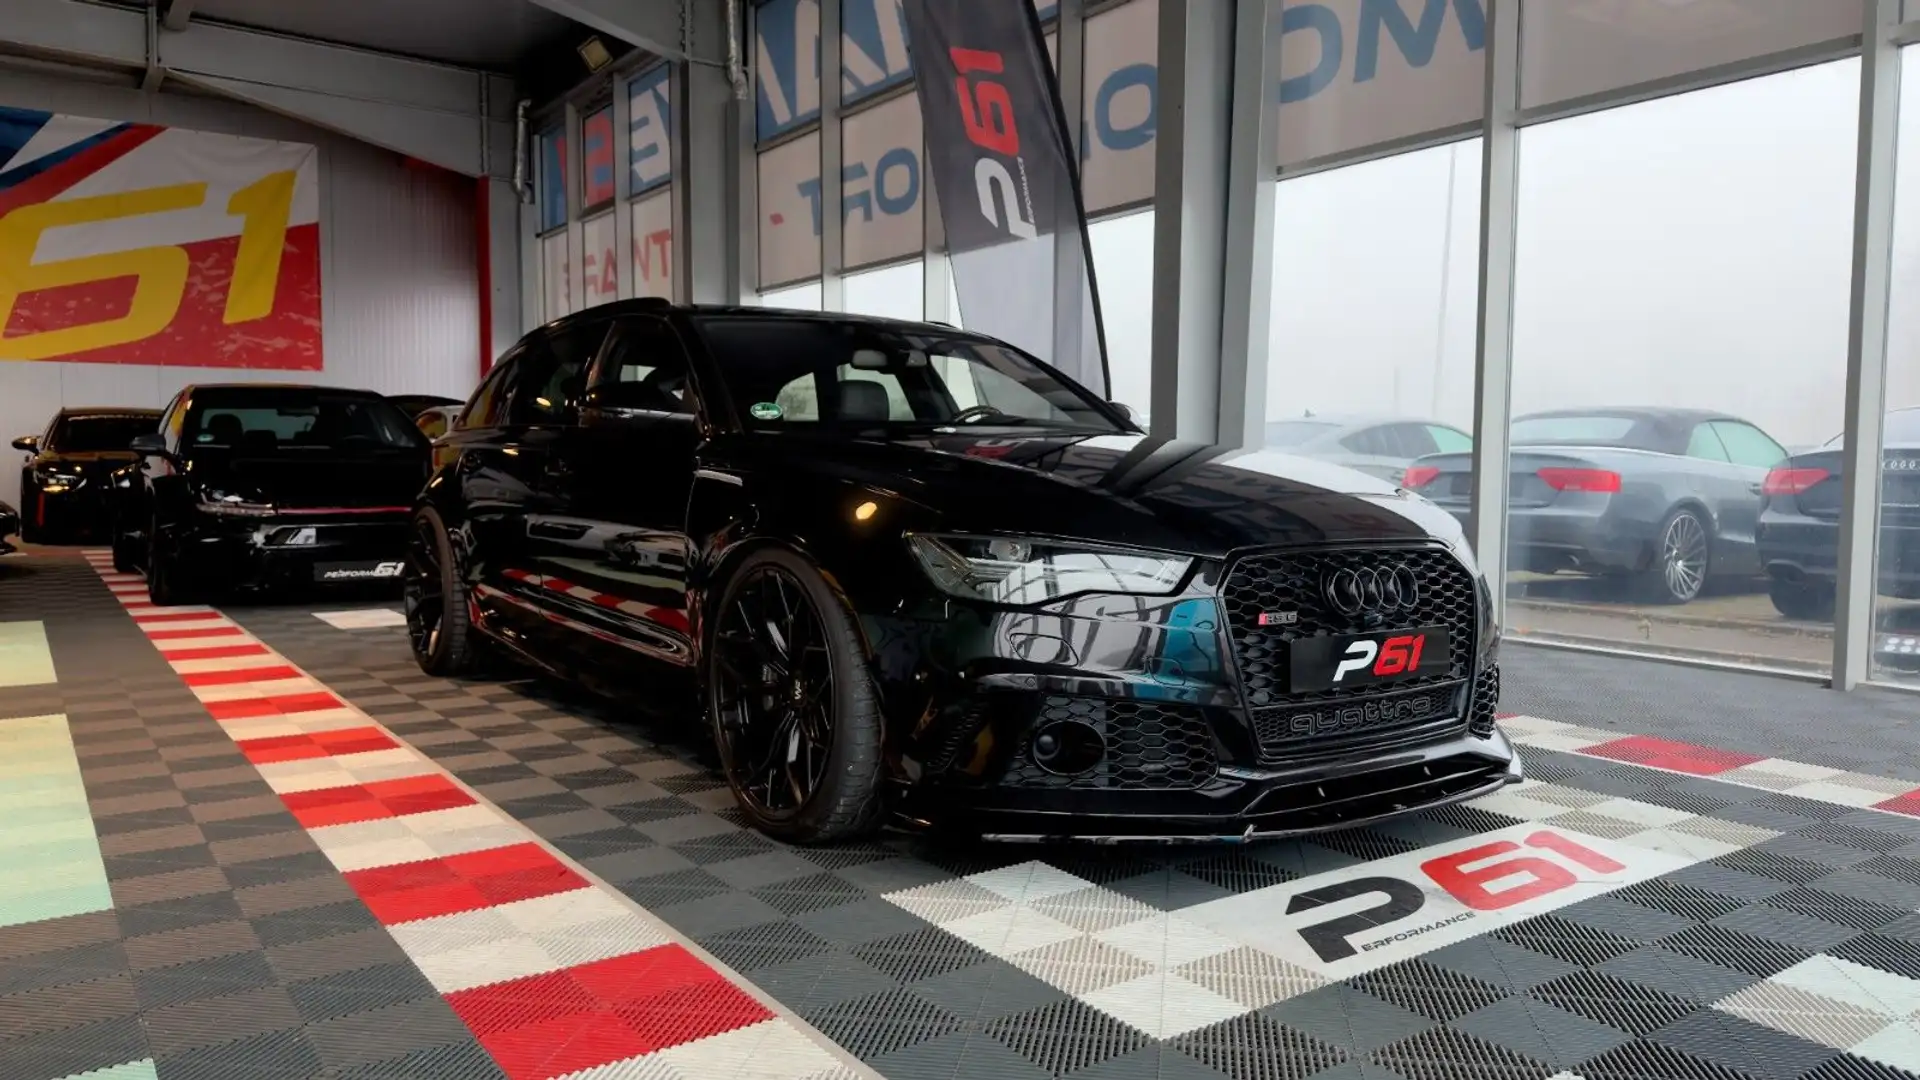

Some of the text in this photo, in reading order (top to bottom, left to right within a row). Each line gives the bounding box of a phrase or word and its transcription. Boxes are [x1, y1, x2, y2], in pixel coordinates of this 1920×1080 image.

[948, 45, 1038, 241] P61
[1332, 634, 1425, 682] P61
[1290, 696, 1431, 735] quattro
[1285, 829, 1627, 964] P61
